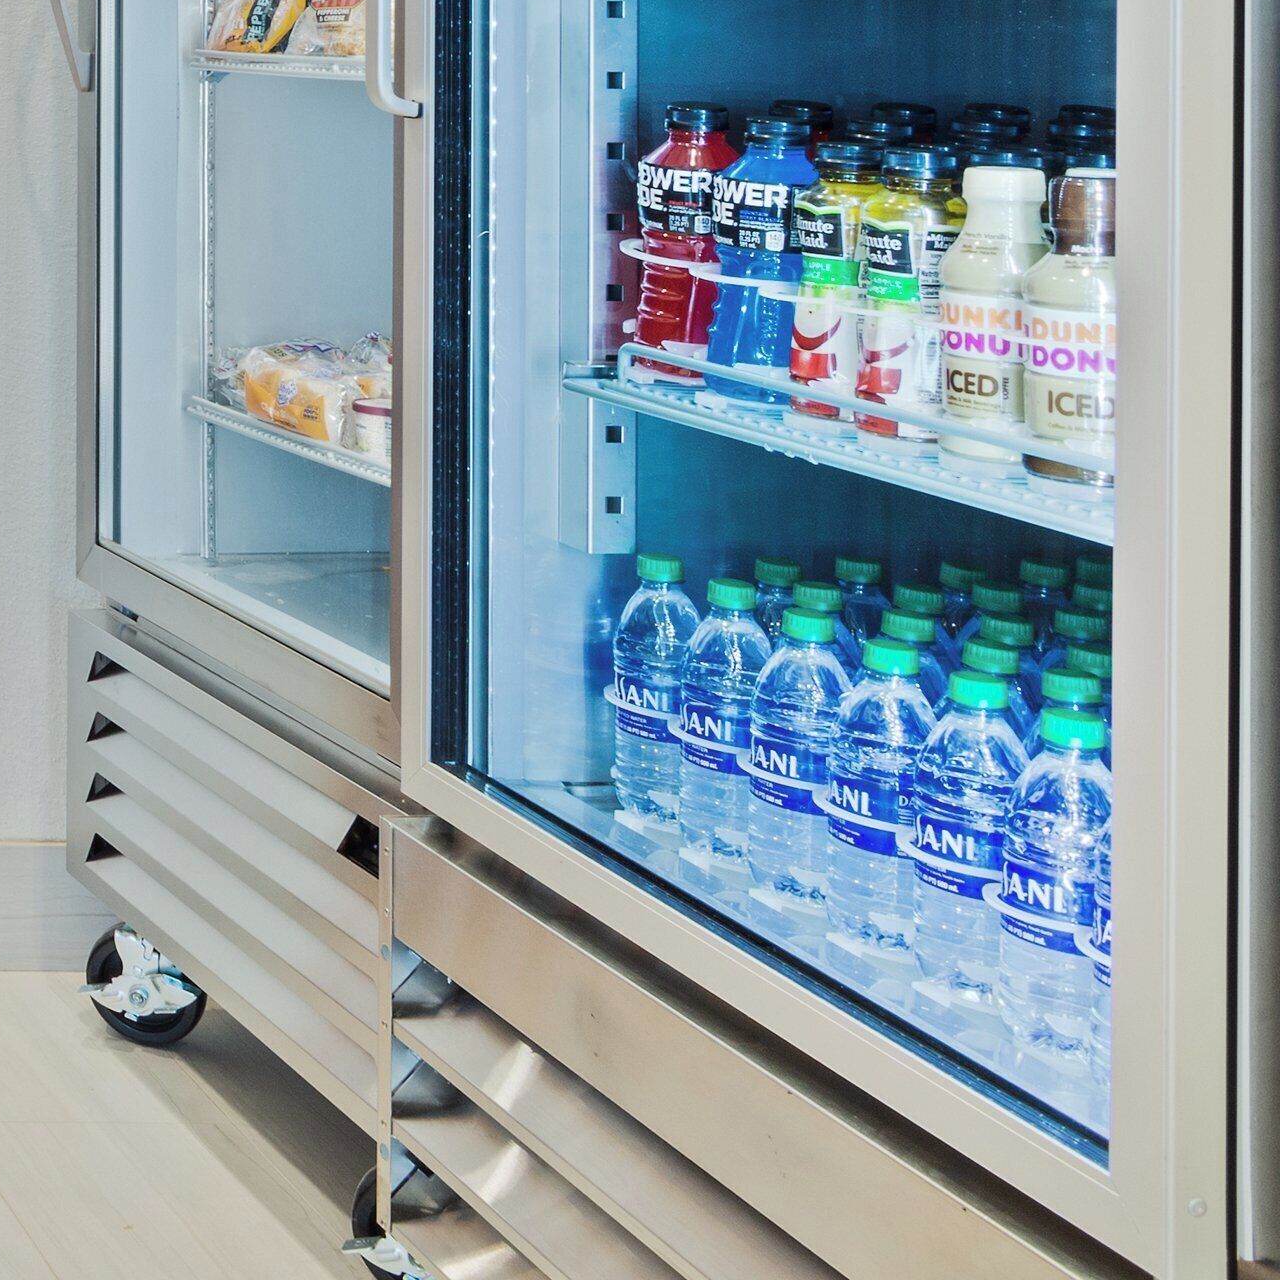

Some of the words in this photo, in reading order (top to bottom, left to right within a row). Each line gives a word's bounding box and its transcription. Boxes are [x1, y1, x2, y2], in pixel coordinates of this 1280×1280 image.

[638, 161, 713, 194] OWER
[713, 175, 787, 208] OWER
[796, 216, 835, 234] inute
[866, 234, 902, 251] nute
[946, 368, 999, 397] ICED
[1001, 377, 1010, 400] COFFEE
[615, 676, 669, 712] SANI
[680, 703, 734, 742] SANI
[751, 737, 800, 779] SANI
[915, 814, 980, 862] SANI
[1002, 860, 1068, 914] SANI
